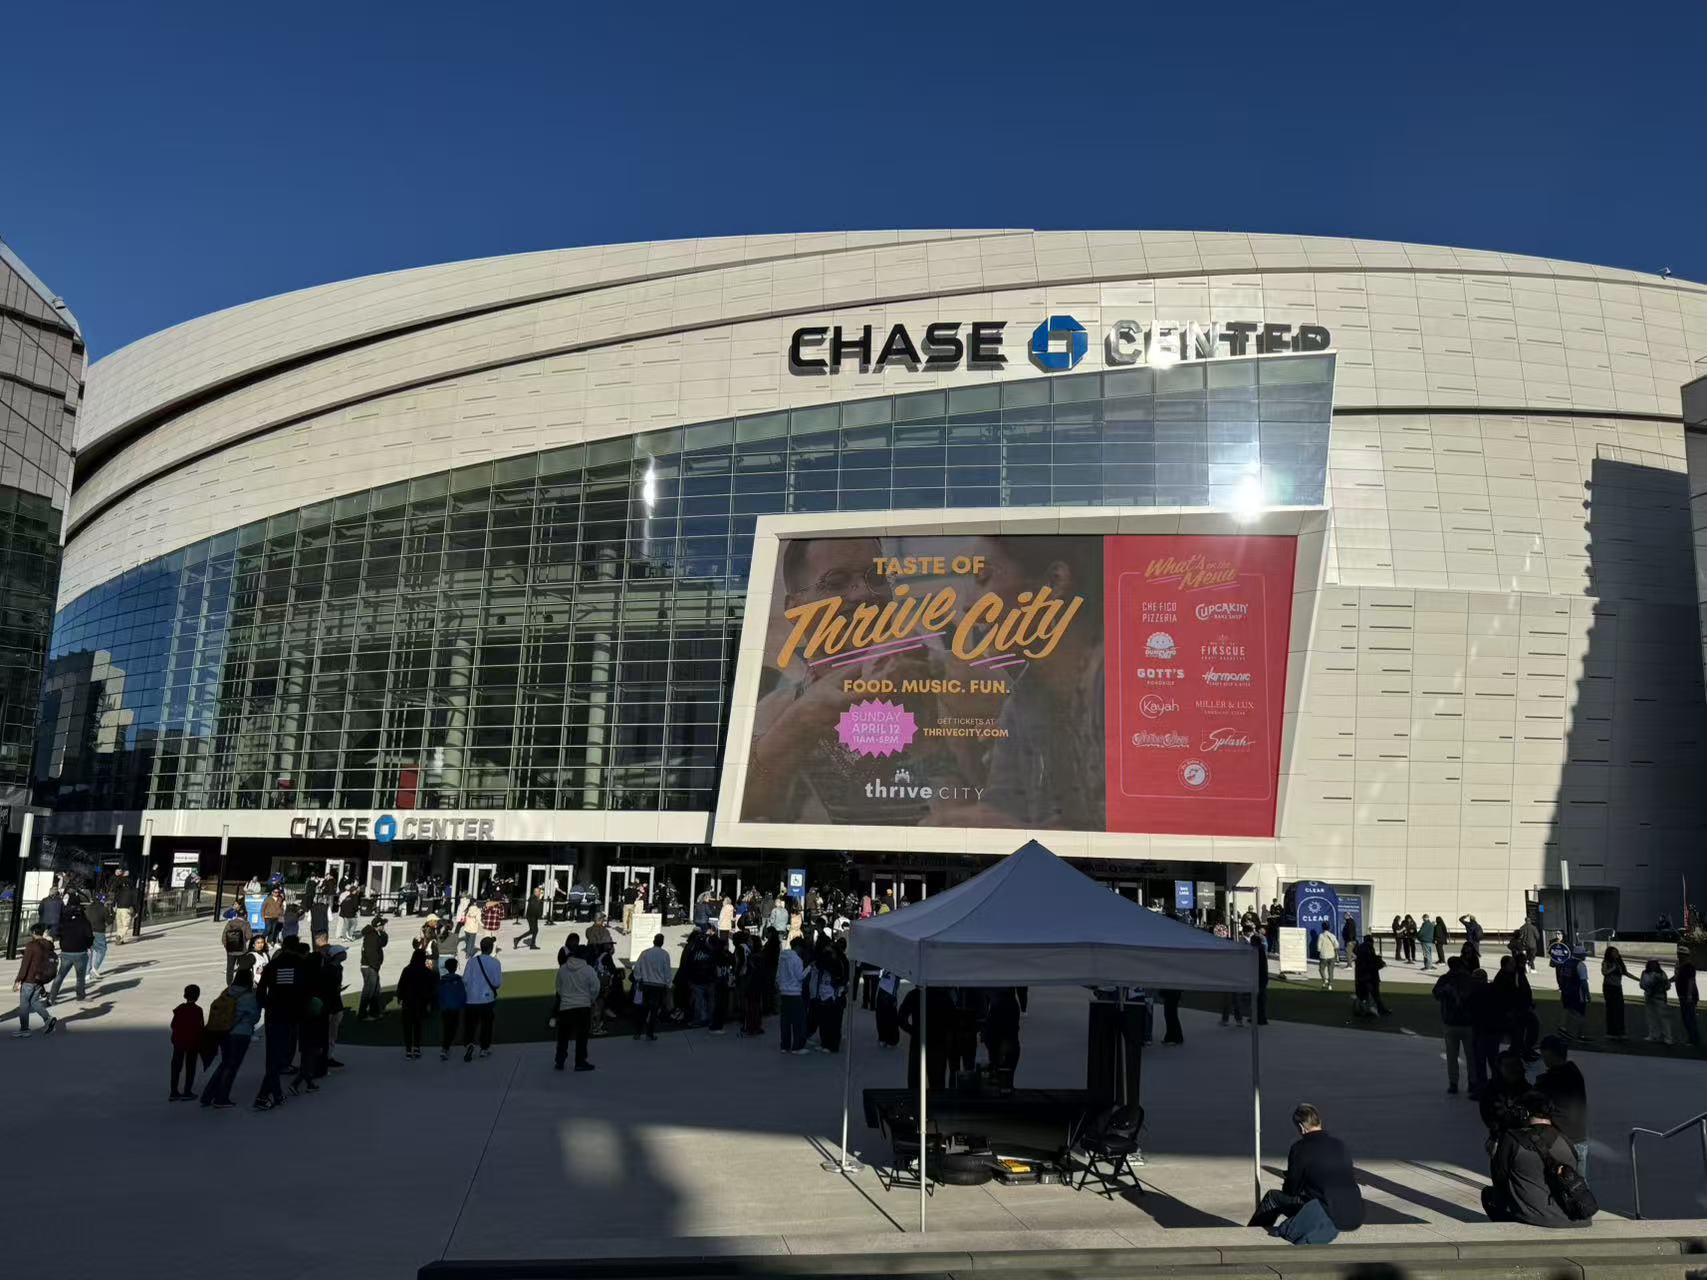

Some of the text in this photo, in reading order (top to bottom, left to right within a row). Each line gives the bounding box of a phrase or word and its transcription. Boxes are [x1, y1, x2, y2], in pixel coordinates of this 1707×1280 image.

[789, 321, 1007, 371] CHASE
[873, 556, 985, 575] TASTE OF
[1144, 554, 1206, 577] What's
[1178, 568, 1237, 590] Menu
[1142, 602, 1177, 612] CHE FICO
[1142, 613, 1178, 622] PIZZERIA
[777, 584, 1084, 670] Thrive City
[1201, 645, 1245, 656] FIKSCUE
[1136, 668, 1185, 679] GOTT'S
[1202, 667, 1251, 683] Harmonic
[843, 679, 1011, 694] FOOD. MUSIC. FUN.
[1143, 699, 1180, 716] Kayah
[1195, 700, 1226, 709] MILLER
[1237, 700, 1254, 709] LUX
[851, 711, 900, 722] SUNDAY
[953, 718, 984, 726] TICKETS
[985, 718, 995, 726] AT
[852, 723, 900, 734] APRIL 12
[923, 728, 1009, 738] THRIVECITY.COM
[1200, 727, 1256, 752] Splash
[864, 778, 985, 800] thrive CITY
[290, 817, 496, 840] CHASE CENTER
[1302, 914, 1329, 922] CLEAR
